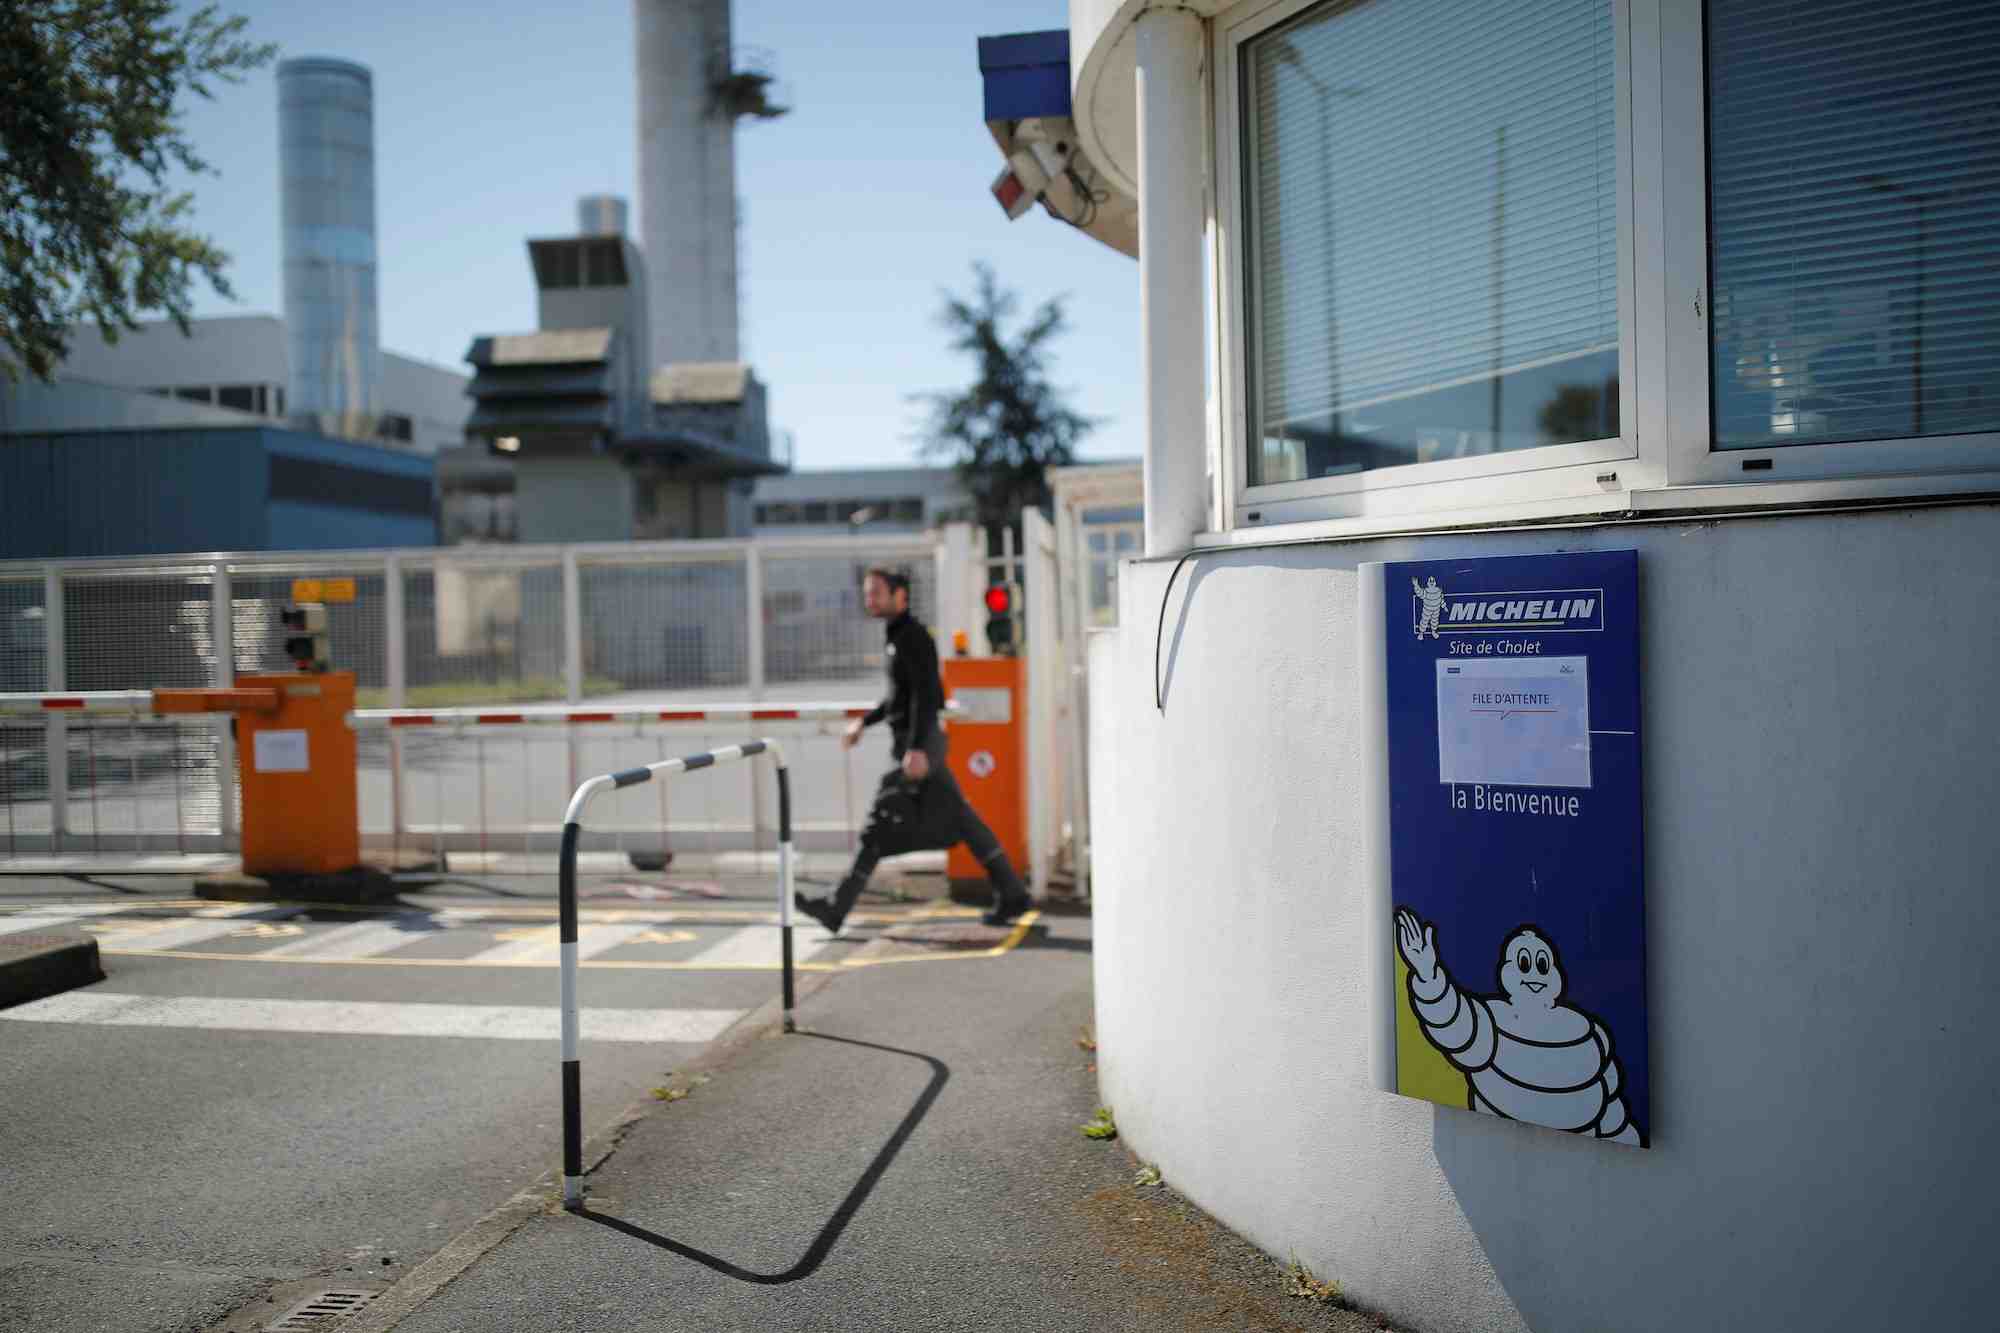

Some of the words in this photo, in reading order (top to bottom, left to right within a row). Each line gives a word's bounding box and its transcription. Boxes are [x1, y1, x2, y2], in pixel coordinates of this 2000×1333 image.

[1448, 599, 1596, 621] MICHELIN
[1449, 640, 1473, 655] Site
[1476, 640, 1493, 655] de
[1496, 639, 1541, 655] Cholet
[1472, 693, 1493, 705] FILE
[1495, 693, 1551, 706] D'ATTENTE
[1451, 784, 1467, 810] la
[1474, 785, 1580, 817] Bienvenue
